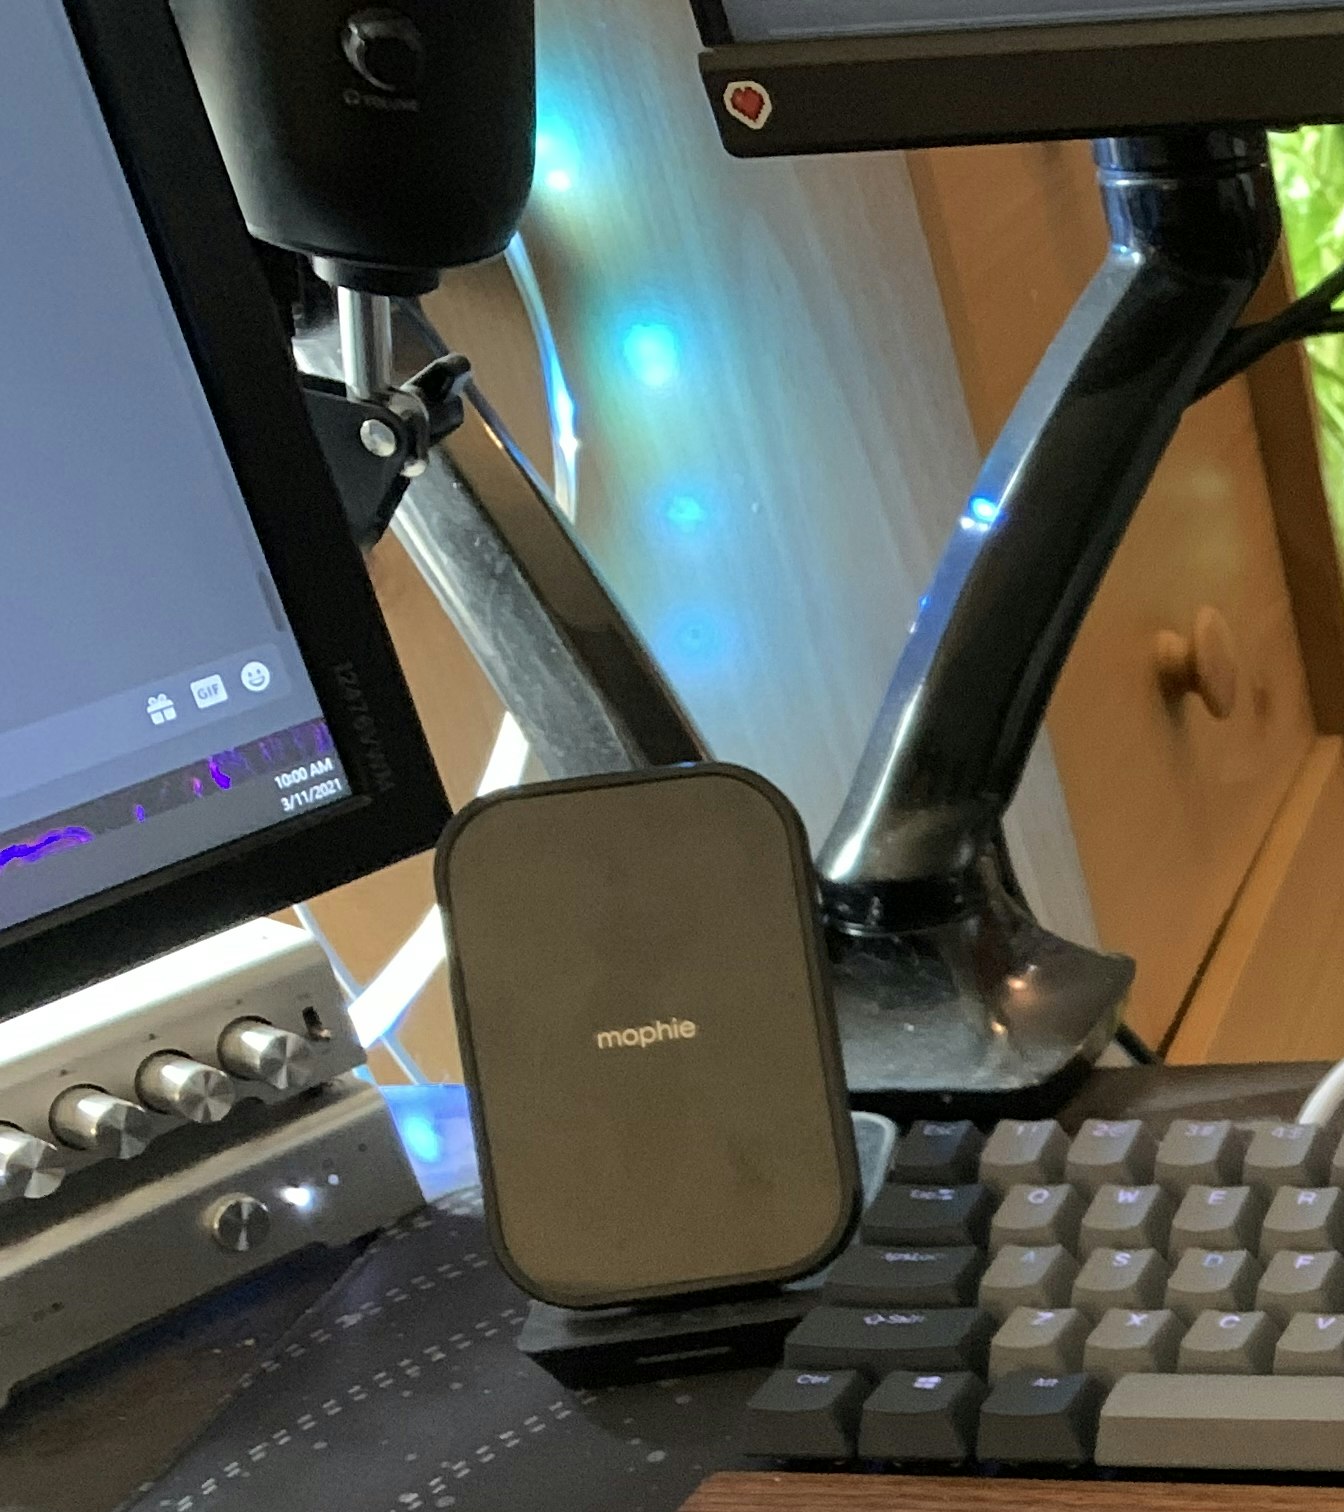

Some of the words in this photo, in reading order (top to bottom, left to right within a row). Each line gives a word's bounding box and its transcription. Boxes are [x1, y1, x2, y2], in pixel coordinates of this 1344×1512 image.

[196, 682, 220, 700] GIF
[274, 765, 309, 790] 10:00
[309, 757, 334, 776] AM
[280, 777, 343, 812] 3/11/2021
[597, 1017, 697, 1049] mophie
[1208, 1190, 1227, 1205] E
[1297, 1191, 1317, 1205] R
[1112, 1252, 1132, 1267] S
[1295, 1255, 1315, 1269] F
[1126, 1313, 1148, 1327] X
[1219, 1315, 1240, 1329] C
[1315, 1316, 1336, 1330] V
